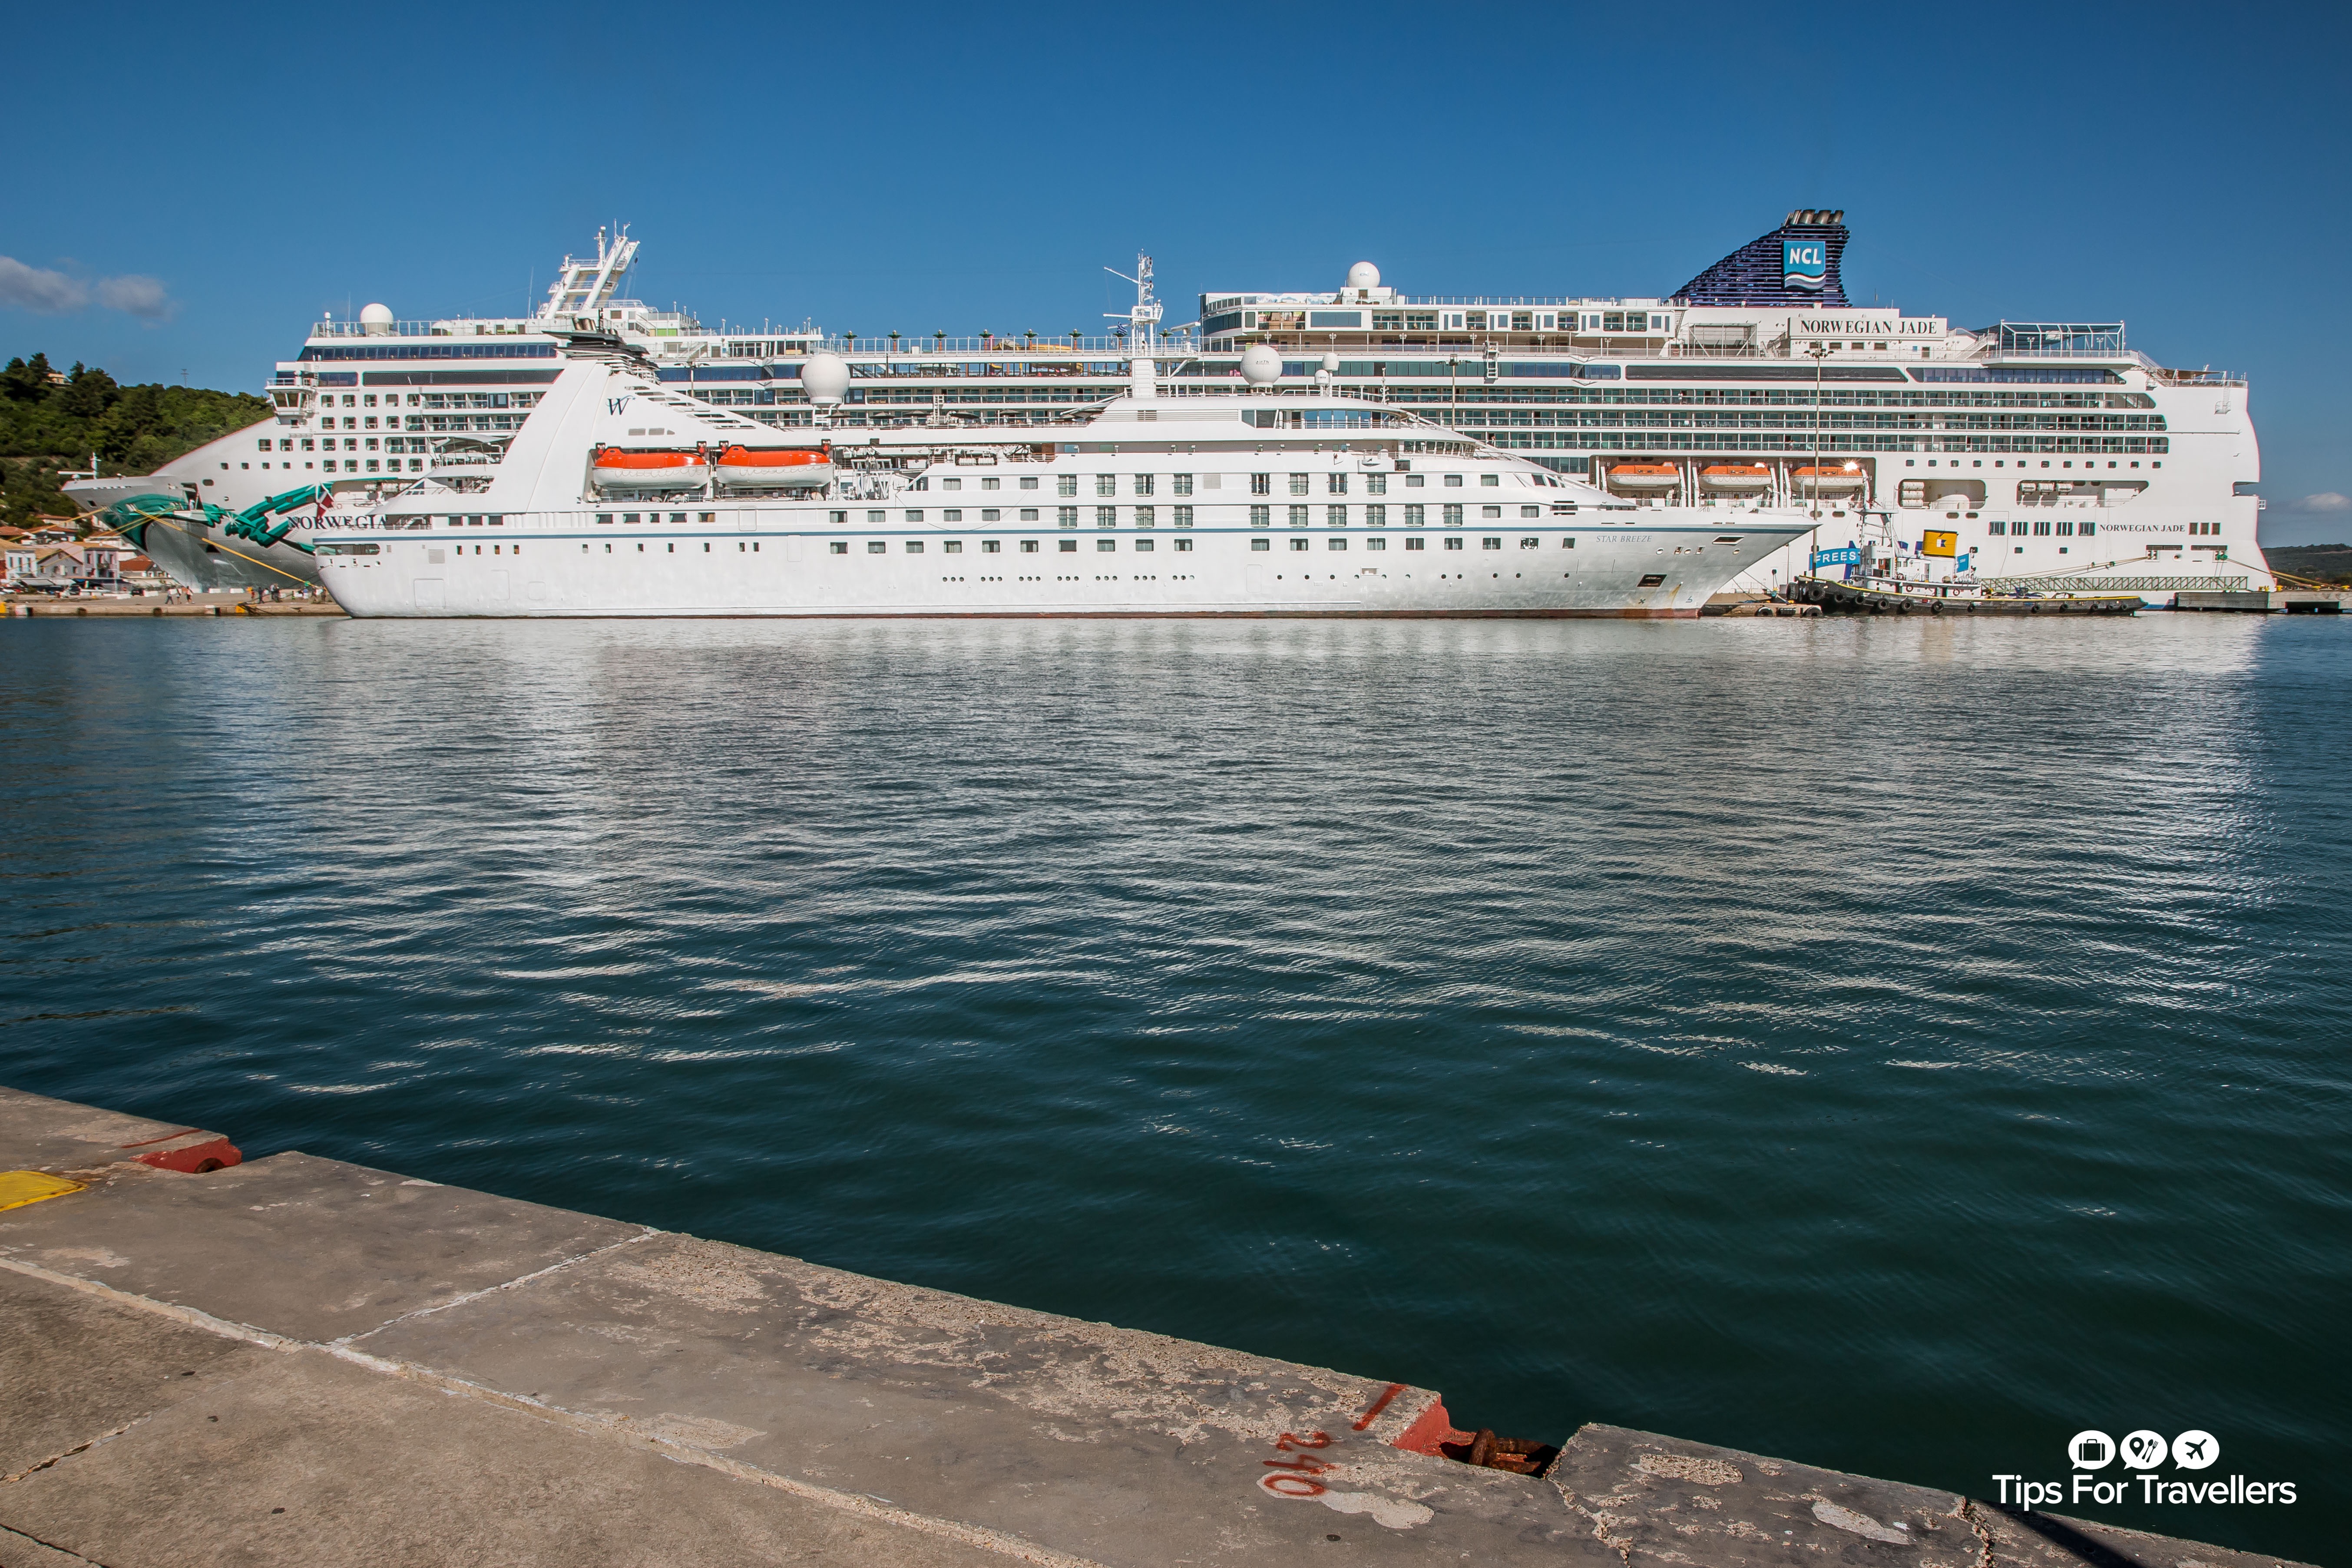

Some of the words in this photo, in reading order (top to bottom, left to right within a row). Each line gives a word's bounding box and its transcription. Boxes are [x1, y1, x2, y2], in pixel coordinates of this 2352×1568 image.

[1789, 248, 1822, 265] NCL
[1800, 320, 1892, 334] NORWEGIAN
[1899, 321, 1937, 334] JADE
